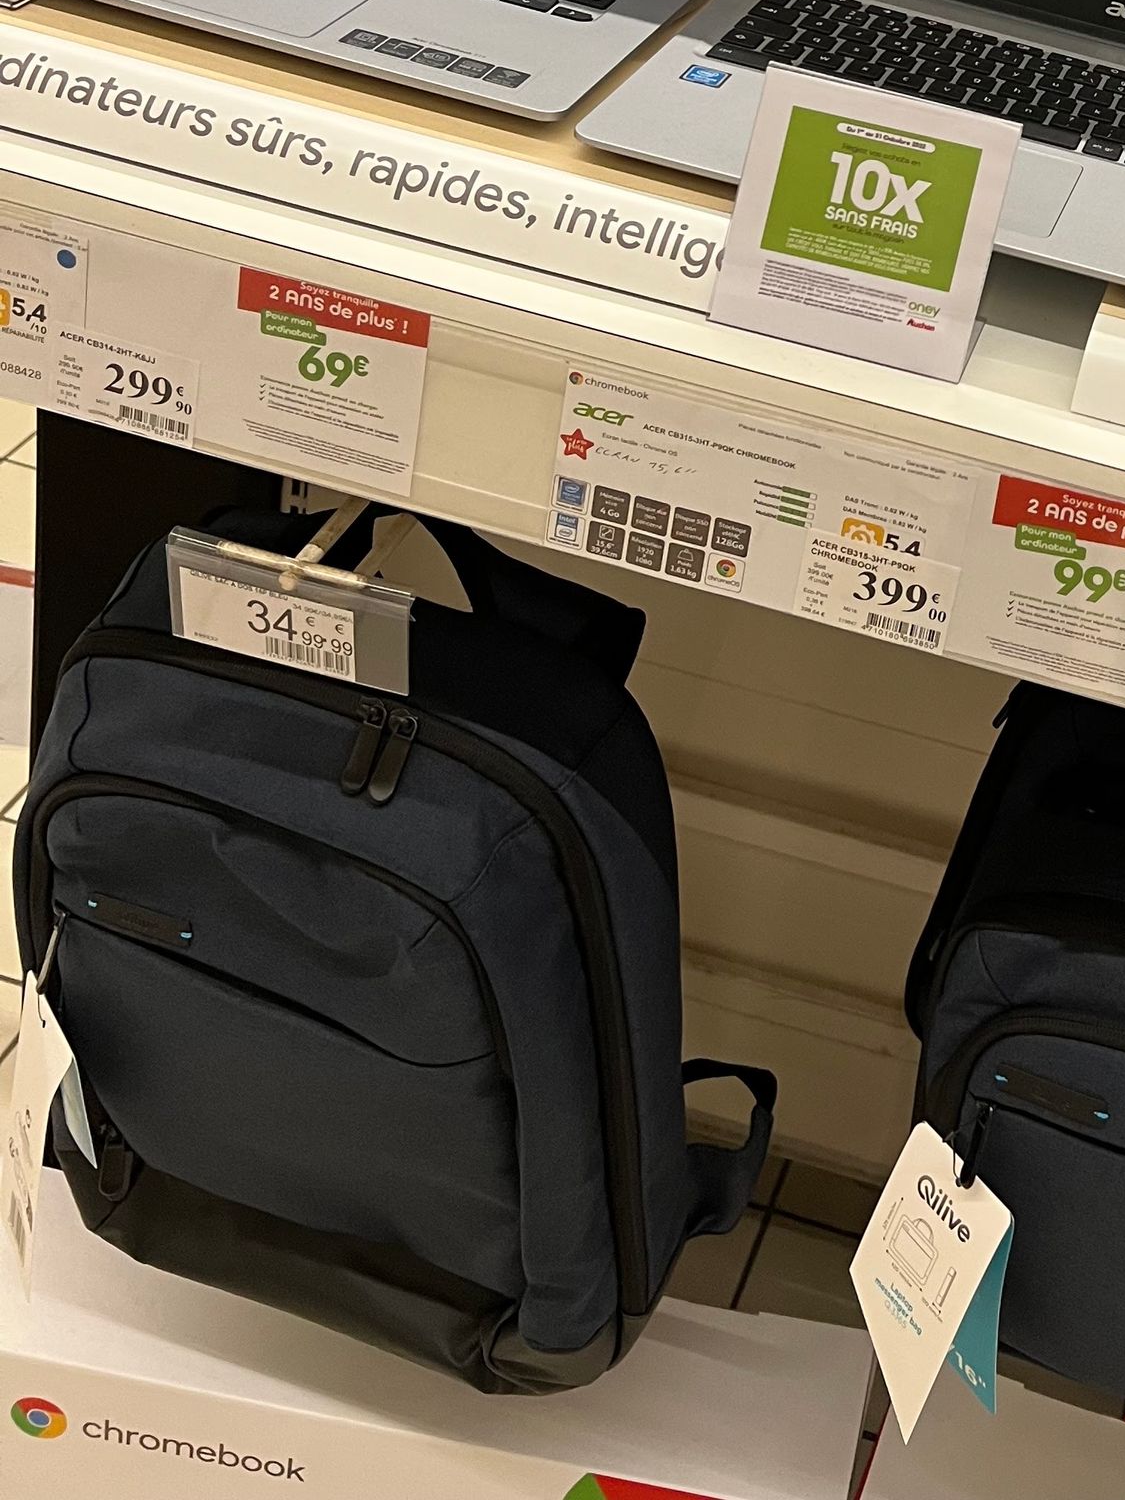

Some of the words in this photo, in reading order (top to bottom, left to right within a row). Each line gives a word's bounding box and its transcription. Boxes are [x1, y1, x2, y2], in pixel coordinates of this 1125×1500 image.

[0, 52, 218, 139] dinateurs
[224, 116, 334, 175] sûrs,
[348, 146, 538, 230] rapides,
[554, 194, 725, 279] intellig
[824, 206, 868, 229] SANS
[870, 215, 919, 240] FRAIS
[300, 281, 330, 298] Soyez
[333, 290, 380, 310] tranquille
[11, 296, 47, 323] 5,4
[265, 311, 290, 323] Pour
[291, 317, 312, 327] mon
[330, 300, 352, 319] de
[908, 300, 941, 318] oney
[60, 330, 85, 345] ACER
[266, 323, 319, 340] ordinateur
[906, 318, 936, 332] Auchan
[298, 345, 370, 388] 69€
[103, 363, 173, 405] 299
[175, 400, 192, 415] 90
[584, 377, 649, 400] chromebook
[572, 402, 635, 427] acer
[642, 423, 666, 436] ACER
[735, 448, 796, 469] CHROMEBOOK
[1062, 494, 1094, 511] Soyez
[1021, 525, 1047, 537] Pour
[1048, 531, 1072, 542] mon
[1092, 515, 1117, 533] de
[812, 538, 839, 552] ACER
[1020, 538, 1078, 555] ordinateur
[810, 548, 879, 573] CHROMEBOOK
[852, 571, 928, 613] 399
[928, 608, 947, 623] 00
[247, 599, 297, 641] 34
[301, 631, 323, 649] 99
[331, 638, 353, 657] 99
[917, 1174, 971, 1244] Qilive
[889, 1282, 913, 1312] Laptop
[82, 1419, 306, 1483] chromebook
